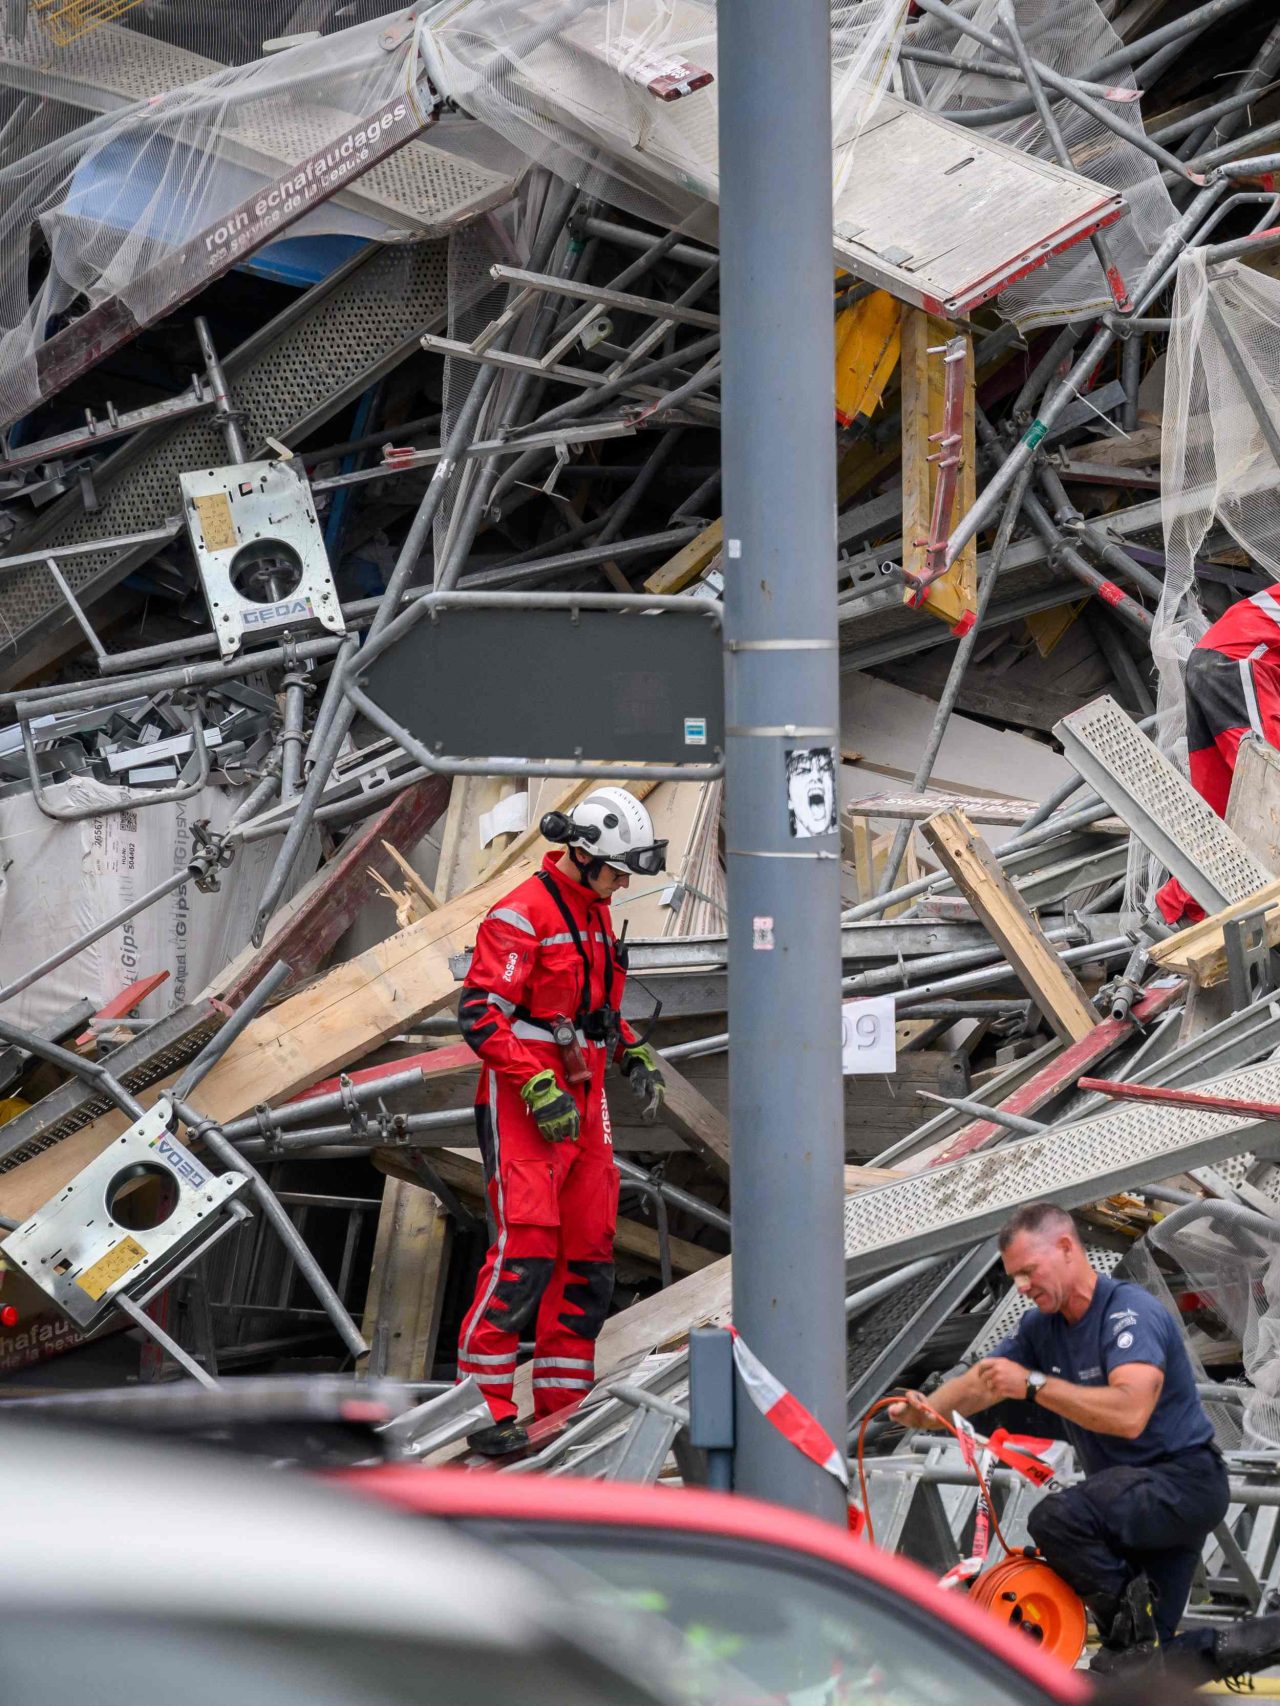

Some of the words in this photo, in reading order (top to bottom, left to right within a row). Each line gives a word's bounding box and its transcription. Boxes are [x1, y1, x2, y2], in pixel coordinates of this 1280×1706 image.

[205, 211, 249, 251] roth
[254, 103, 407, 217] échafaudages
[243, 604, 307, 625] GEDA
[157, 1139, 206, 1188] GEDA
